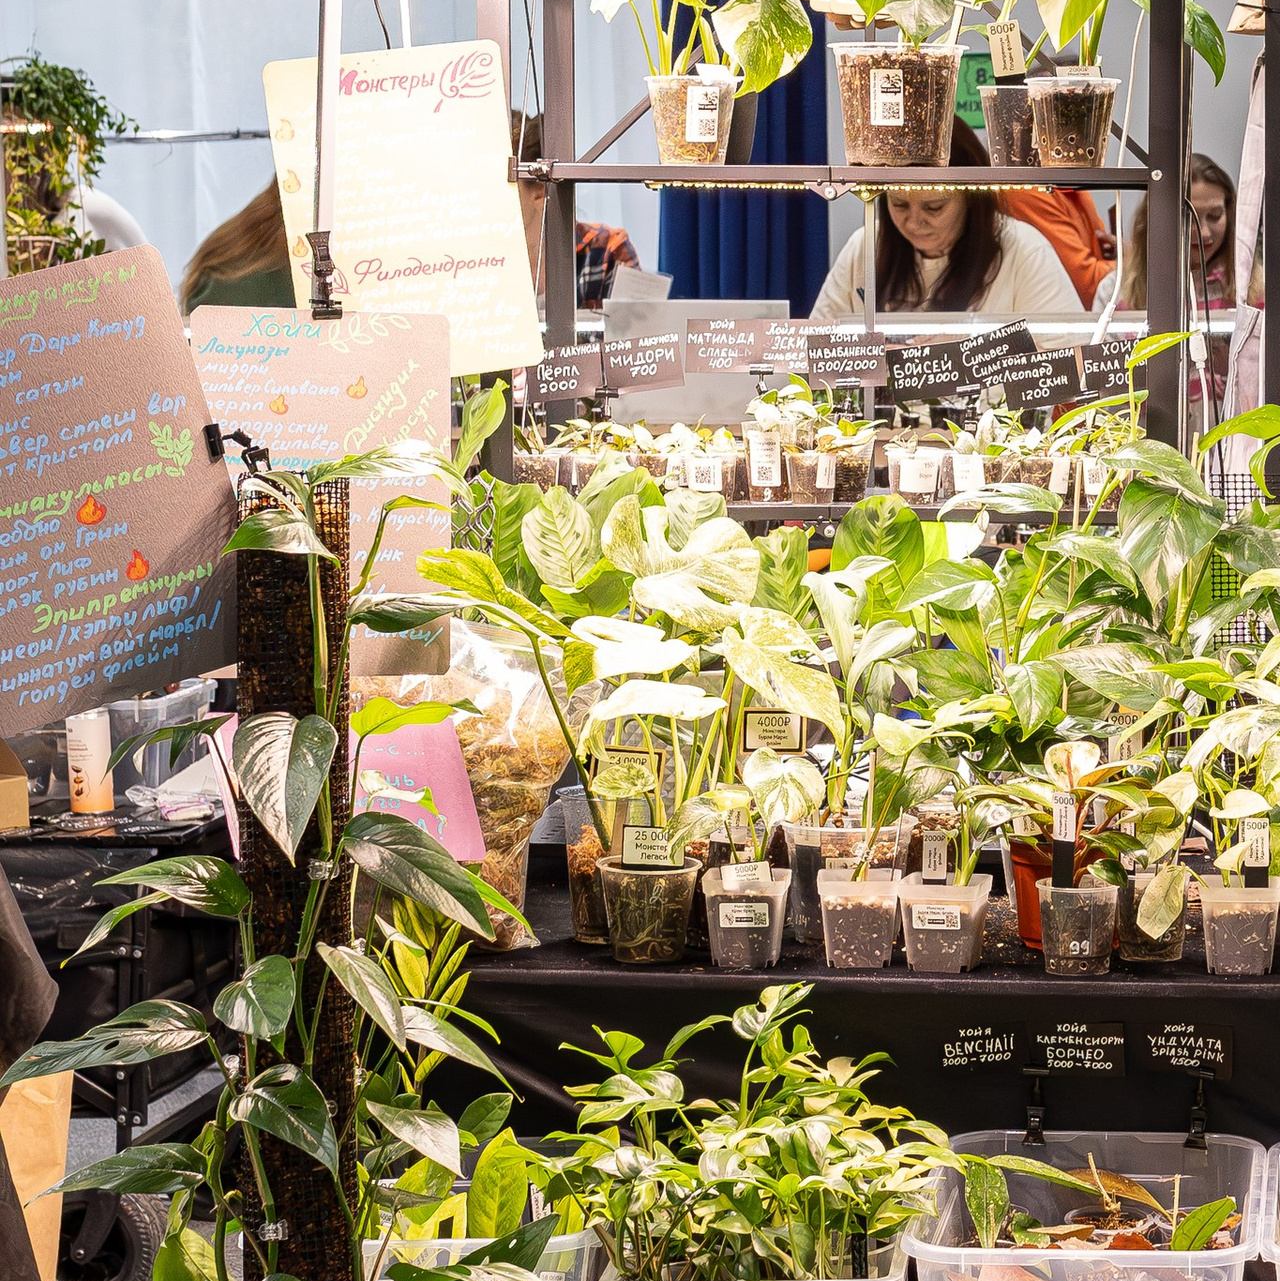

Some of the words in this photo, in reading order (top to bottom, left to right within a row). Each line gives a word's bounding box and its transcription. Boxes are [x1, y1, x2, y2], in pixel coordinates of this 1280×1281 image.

[339, 68, 434, 97] Монстеры
[355, 255, 505, 285] Филодендроны
[242, 313, 321, 338] Хойи
[710, 320, 735, 331] ХОЙЯ
[989, 319, 1027, 342] ЛАКУНОЗА
[20, 333, 81, 355] Дарк
[88, 315, 145, 340] Клауд
[687, 332, 755, 346] МАТИЛЬДА
[830, 332, 859, 343] ХОЙЯ
[200, 338, 290, 362] Лакунозы
[560, 343, 600, 357] ЛАКУНОЗА
[605, 341, 632, 353] ХОЙЯ
[638, 333, 679, 348] ЛАКУНОЗА
[810, 344, 884, 357] НАВАБАНЕНСИС
[610, 348, 675, 367] МИДОРИ
[902, 346, 930, 358] ХОЙЯ
[962, 343, 1009, 365] Сильвер
[1000, 354, 1027, 367] ХОЙЯ
[1030, 347, 1074, 363] ЛАКУНОЗА
[630, 363, 657, 377] 700
[708, 358, 732, 369] 400
[813, 359, 878, 372] 1500/2000
[893, 354, 952, 378] БОЙСЕЙ
[1085, 360, 1118, 374] БЕЛЛА
[537, 364, 580, 381] ПЁРПЛ
[1006, 364, 1053, 383] Леопард
[540, 379, 578, 393] 2000
[894, 372, 959, 389] 1500/3000
[1039, 374, 1069, 387] СКИН
[15, 376, 83, 405] сатин
[1021, 388, 1050, 400] 1200
[60, 408, 135, 440] сплеш
[25, 428, 132, 477] кристалл
[33, 563, 212, 634] Эпипремнумы
[18, 671, 95, 707] голден
[103, 643, 179, 682] флейм
[1054, 796, 1074, 805] 5000
[634, 831, 647, 840] 25
[641, 853, 668, 861] Легаси
[959, 1027, 991, 1037] ХОЙЯ
[1056, 1022, 1087, 1033] ХОЙЯ
[1164, 1023, 1194, 1034] ХОЙЯ
[945, 1034, 1015, 1058] BENCHAII
[1148, 1035, 1222, 1051] УНДУЛАТА
[1046, 1047, 1104, 1060] БОРНЕО
[1170, 1057, 1200, 1067] 4500
